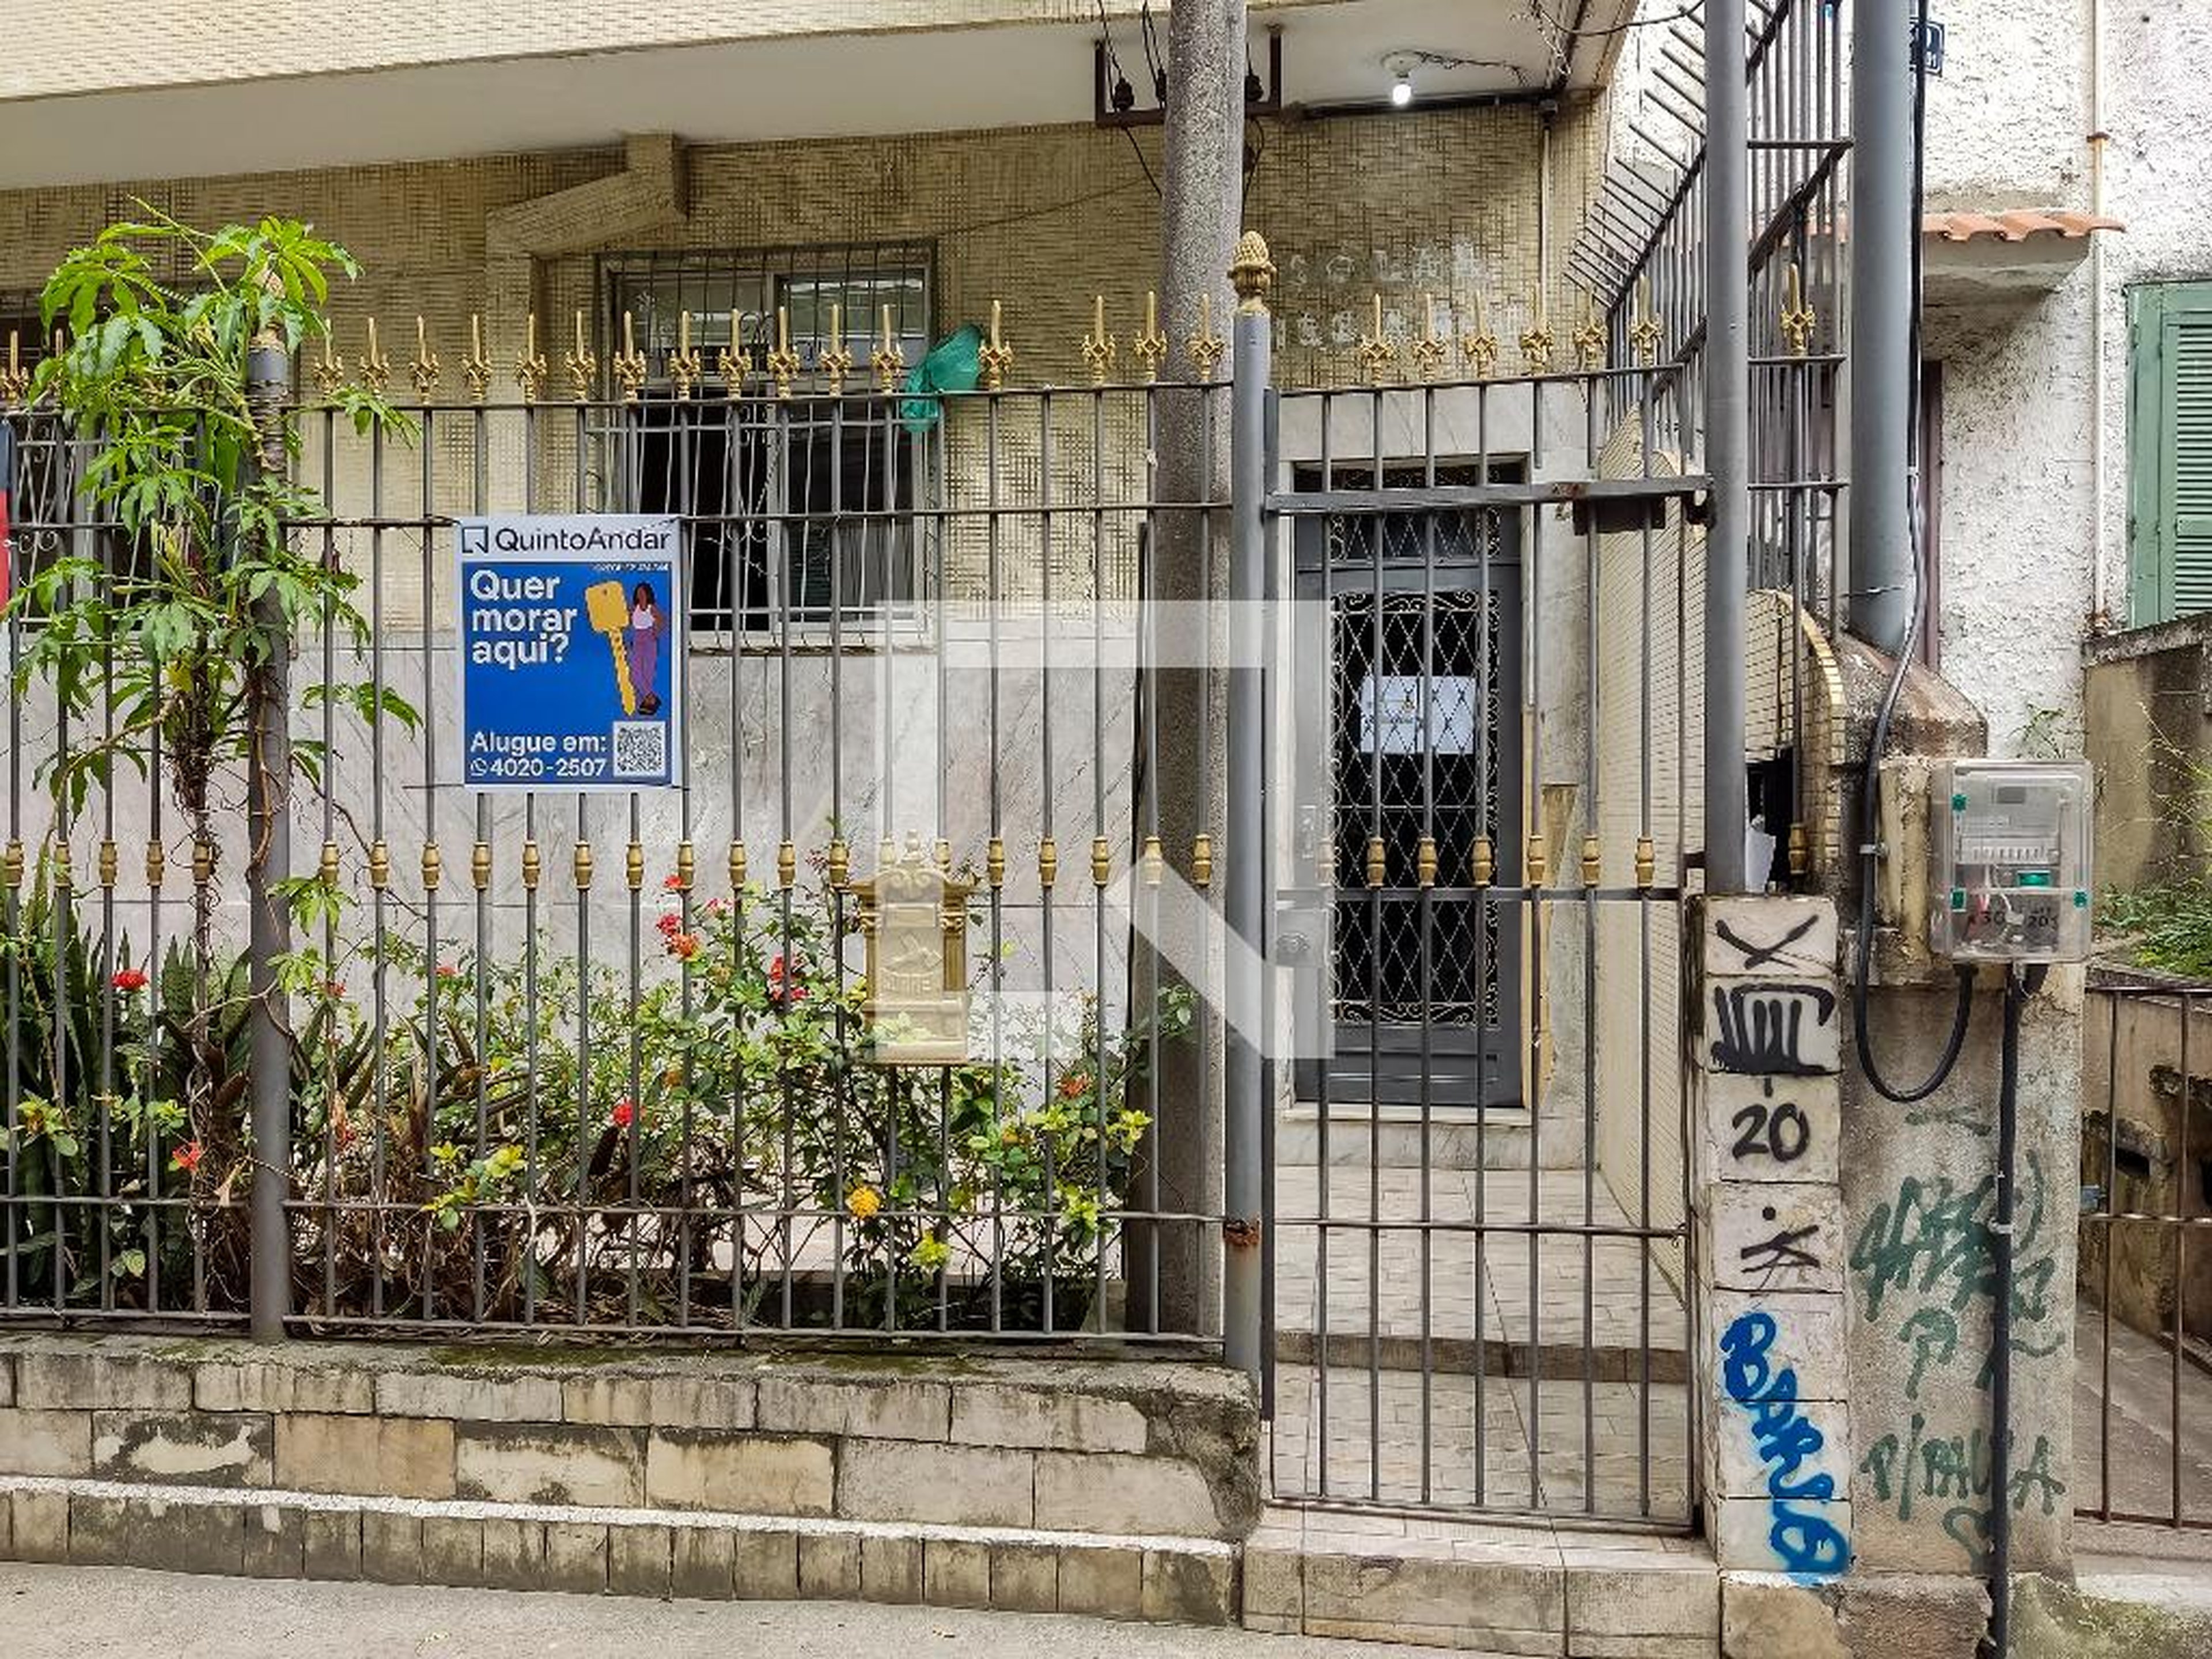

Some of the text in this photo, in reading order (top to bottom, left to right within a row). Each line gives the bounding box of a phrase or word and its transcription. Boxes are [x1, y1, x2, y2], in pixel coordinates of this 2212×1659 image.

[495, 527, 671, 551] QuintoAndar
[471, 569, 560, 601] Quer
[472, 608, 577, 631] morar
[472, 632, 569, 670] aqui?
[470, 731, 607, 756] Alugue em:
[1732, 1103, 1810, 1164] 20
